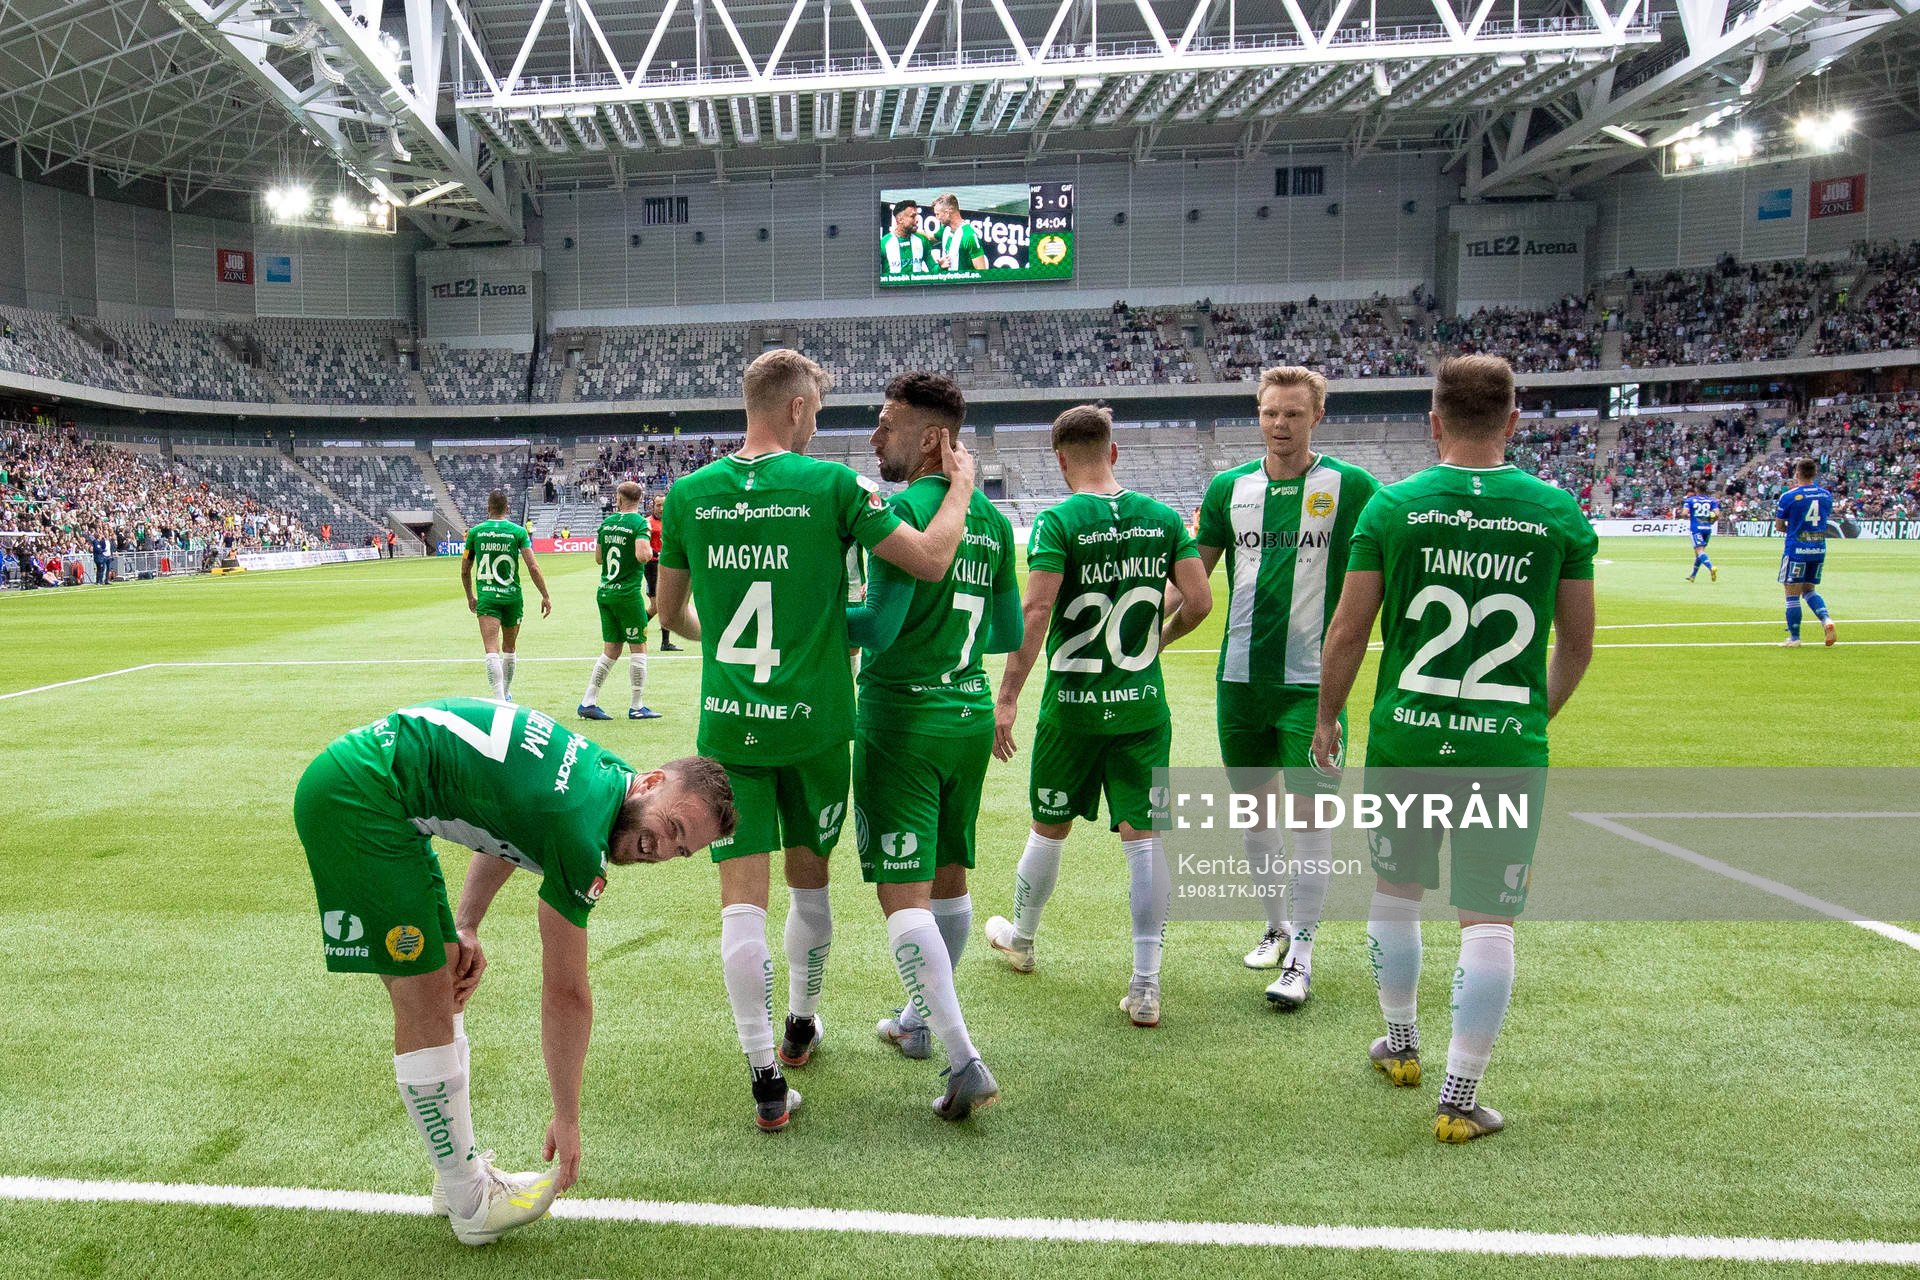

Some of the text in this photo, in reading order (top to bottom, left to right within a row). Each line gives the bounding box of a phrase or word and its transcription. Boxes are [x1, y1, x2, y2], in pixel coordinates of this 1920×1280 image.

[1035, 195, 1044, 209] 3
[1058, 194, 1068, 208] 0
[1821, 182, 1850, 201] JOB
[1819, 201, 1853, 215] ZONE
[1035, 216, 1067, 229] 84:04
[1466, 235, 1578, 257] TELE2 Arena
[225, 253, 244, 270] JOB
[223, 270, 247, 281] ZONE
[431, 278, 527, 299] TELE2 Arena
[695, 504, 811, 522] Sefina pantbank
[1693, 502, 1710, 517] 28
[1805, 499, 1821, 527] 4
[1407, 509, 1548, 537] Sefina pantbank
[1632, 523, 1677, 533] CRAFT
[1078, 527, 1165, 546] Sefina pantbank
[1235, 531, 1332, 549] JOBMAN
[606, 546, 621, 580] 6
[707, 545, 789, 570] MAGYAR
[1081, 552, 1168, 585] KAČANIKLIĆ
[1421, 547, 1535, 584] TANKOVIĆ
[477, 553, 516, 586] 40
[716, 581, 781, 684] 4
[941, 592, 985, 684] 7
[1050, 586, 1163, 674] 20
[1398, 584, 1536, 705] 22
[1057, 688, 1139, 704] SILJA LINE
[704, 696, 788, 719] SILJA LINE
[1393, 706, 1497, 734] SILJA LINE
[1147, 810, 1169, 819] front
[883, 860, 920, 870] fronta
[325, 943, 369, 957] fronta
[807, 942, 832, 998] Clinton
[895, 943, 932, 1018] Clinton
[408, 1081, 454, 1159] Clinton
